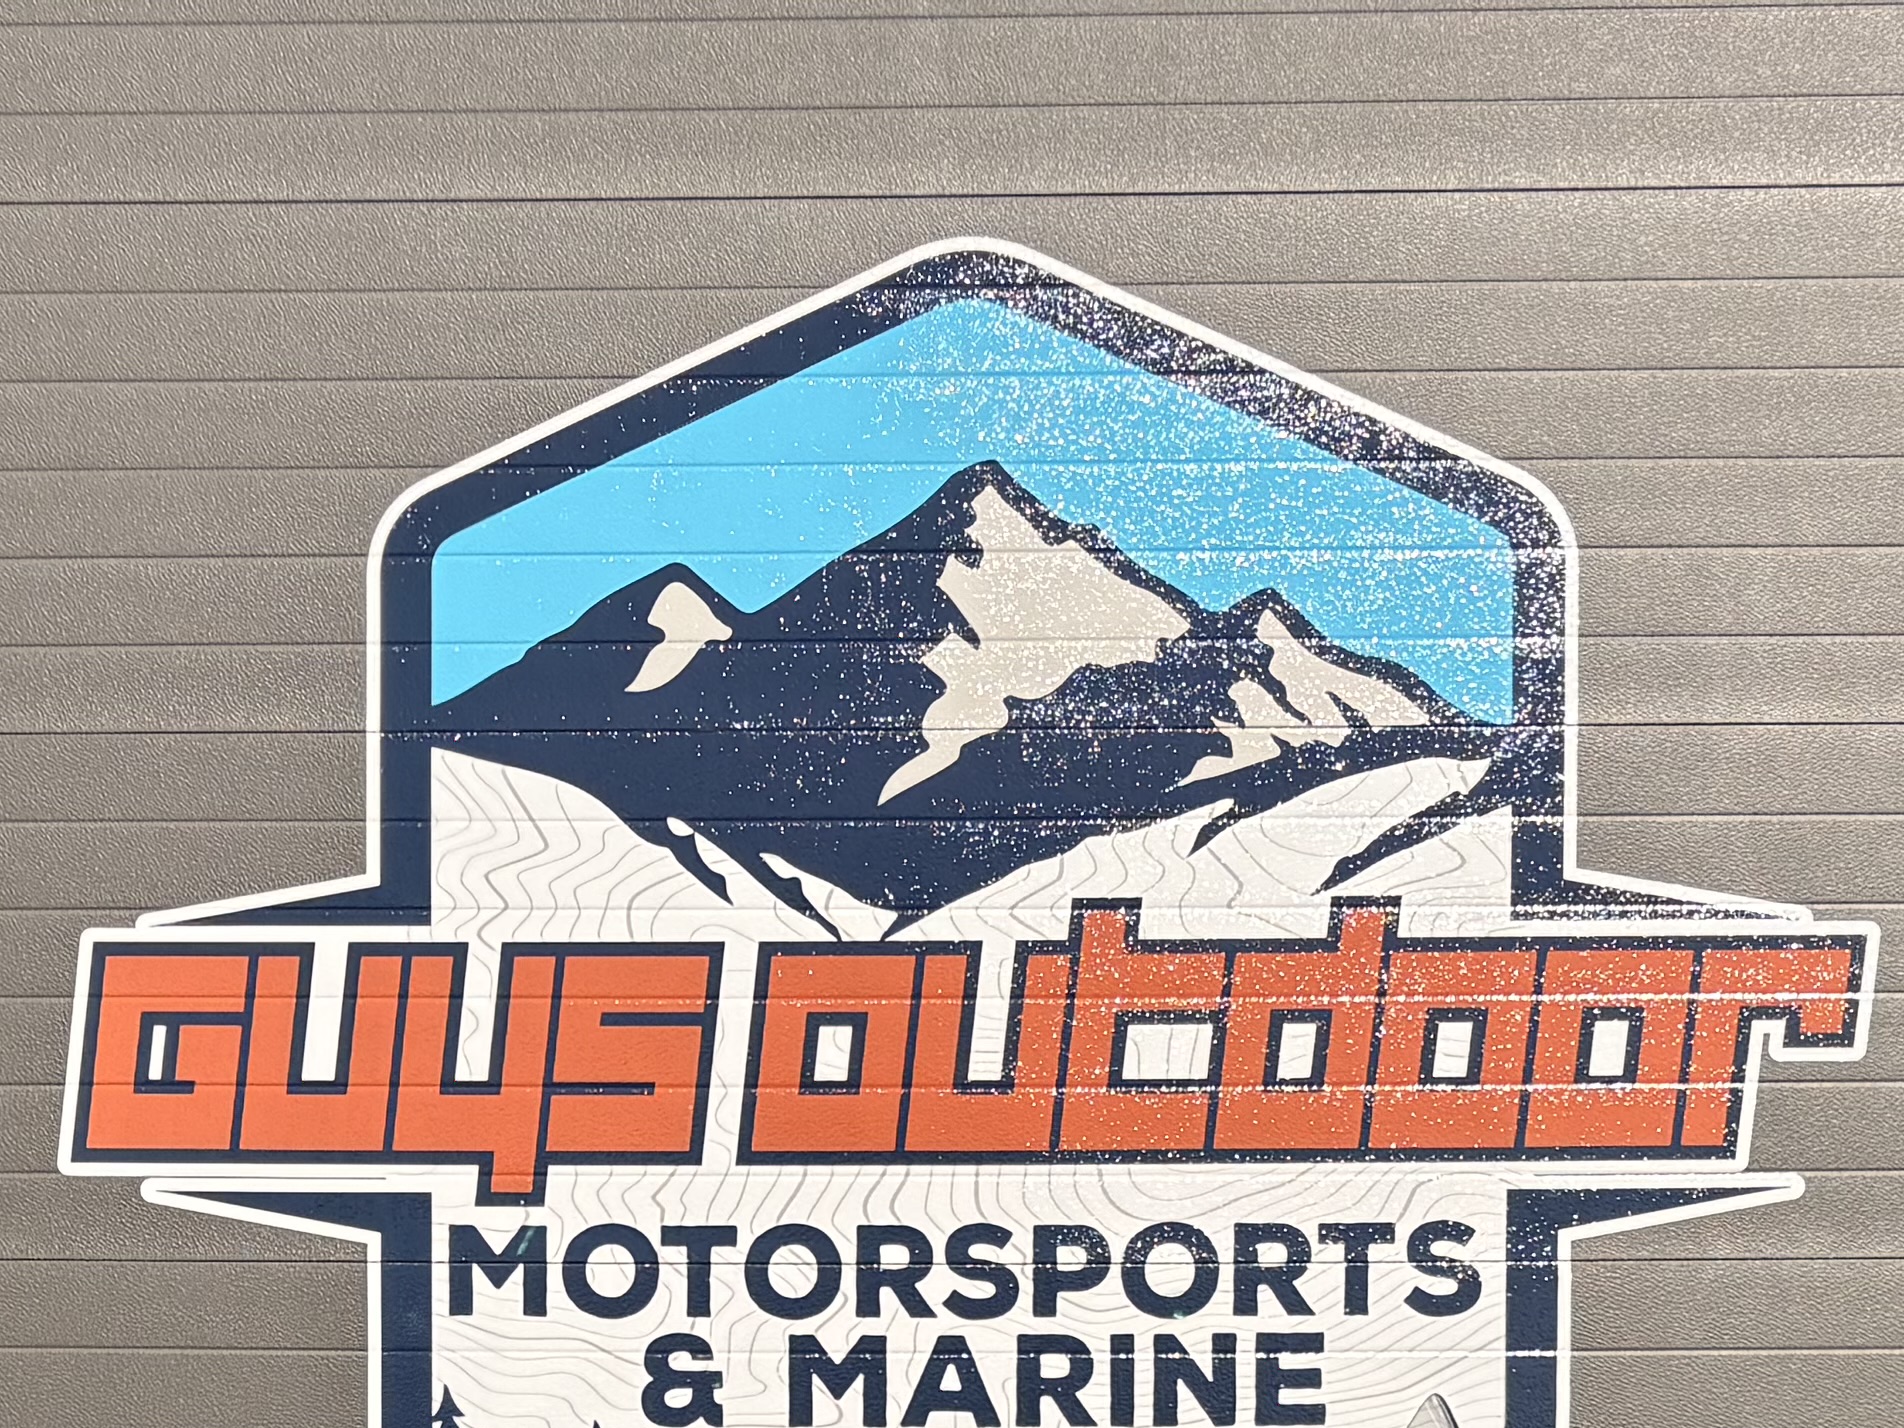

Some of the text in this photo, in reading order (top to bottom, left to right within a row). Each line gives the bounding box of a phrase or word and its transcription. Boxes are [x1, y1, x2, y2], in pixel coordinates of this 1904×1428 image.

[446, 1219, 1481, 1318] MOTORSPORTS
[641, 1332, 1326, 1428] & MARINE
